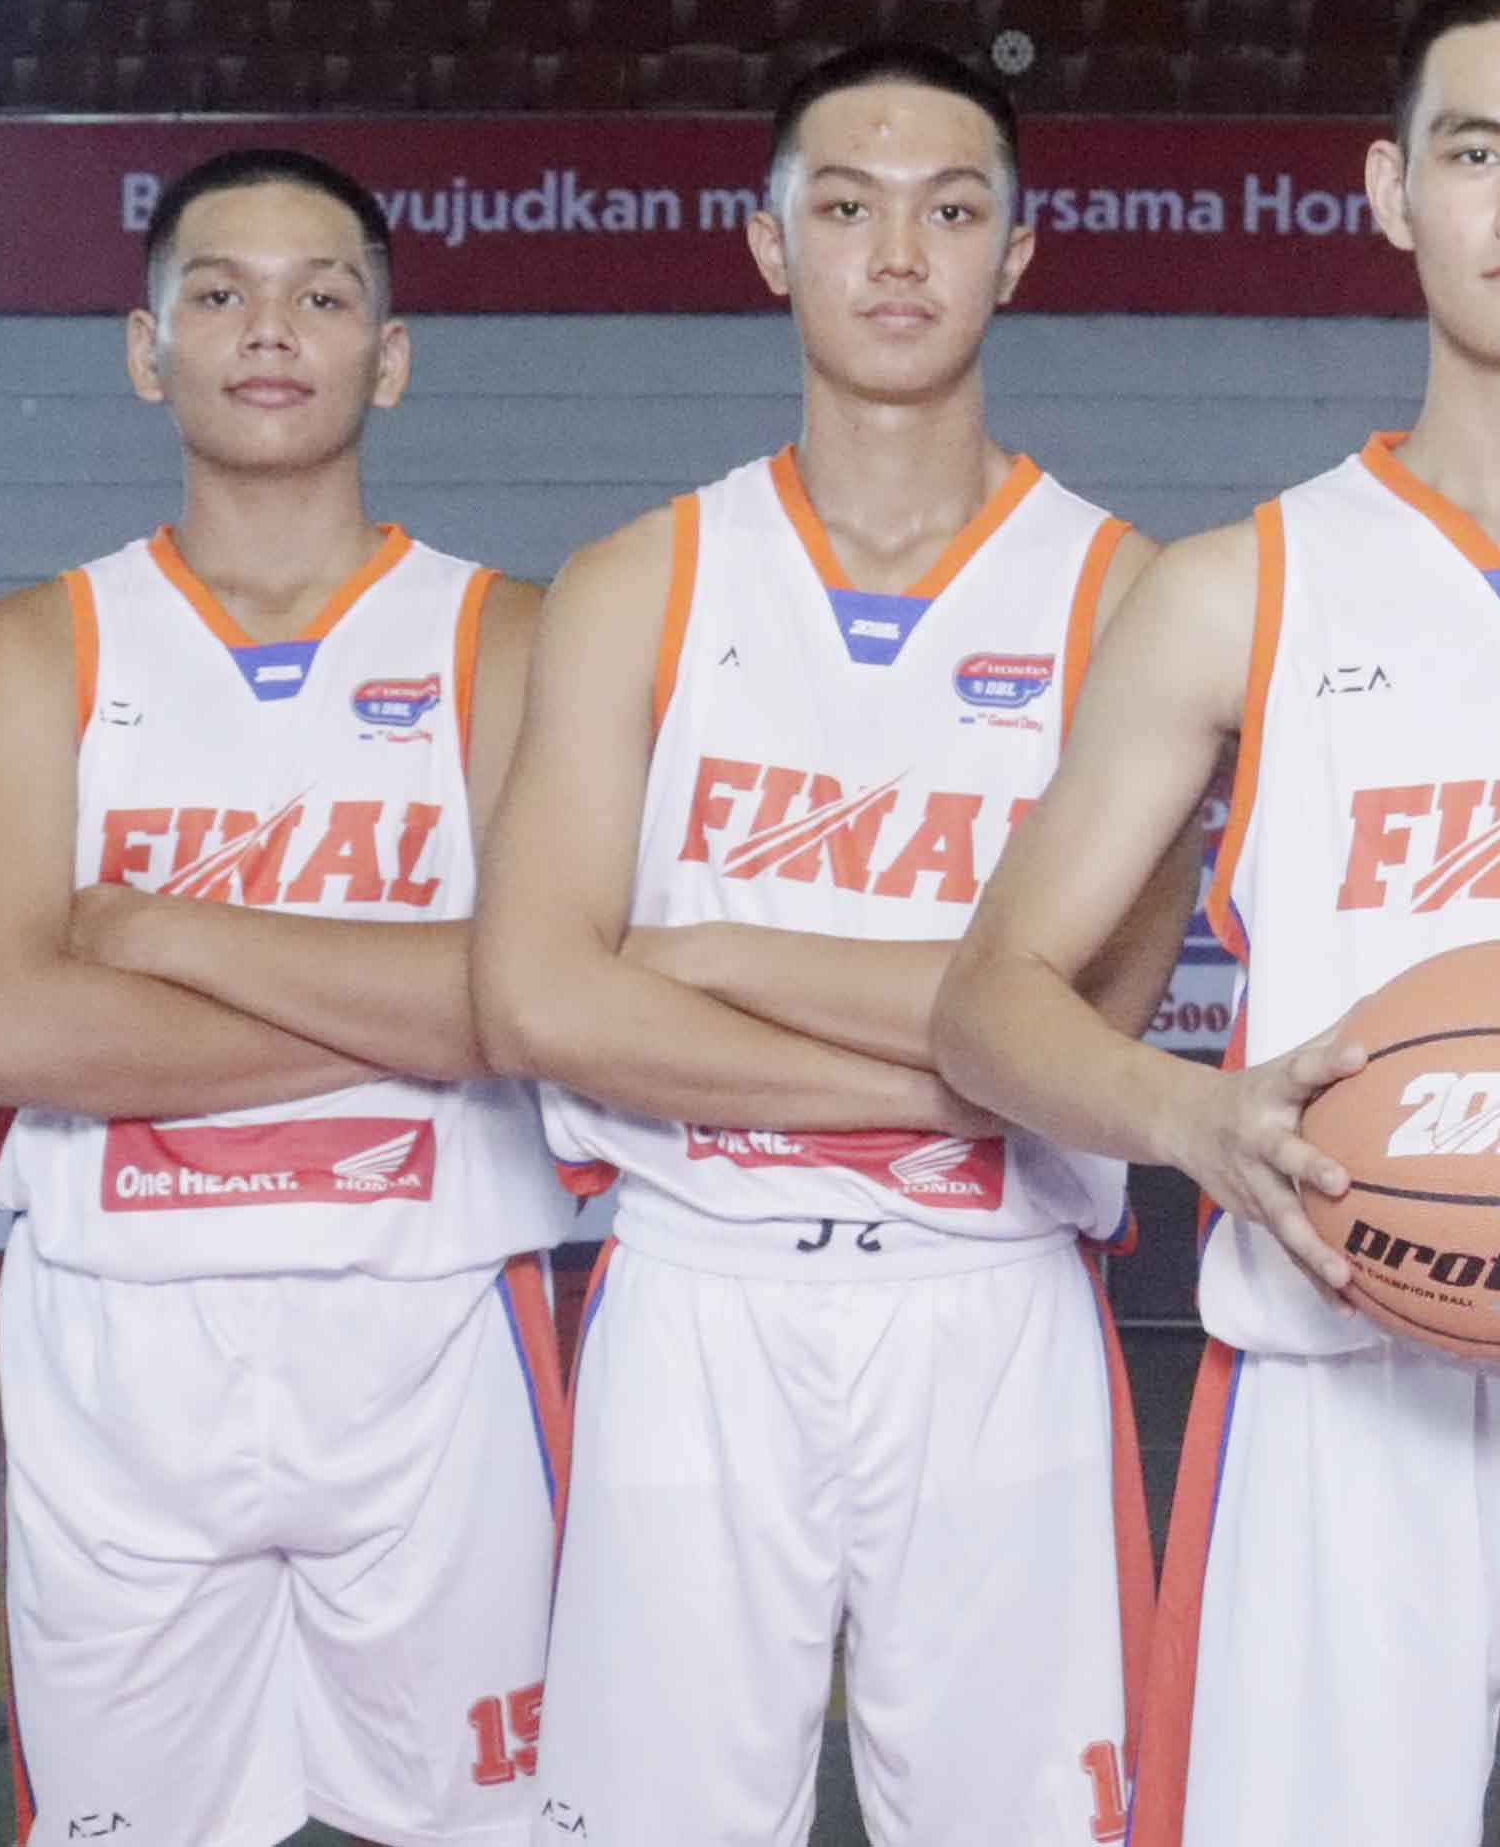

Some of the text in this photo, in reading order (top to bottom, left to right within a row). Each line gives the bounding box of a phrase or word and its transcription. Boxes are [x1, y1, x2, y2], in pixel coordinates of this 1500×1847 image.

[101, 792, 444, 906] FINAL
[677, 755, 1029, 905] FINA
[116, 1164, 171, 1199] One
